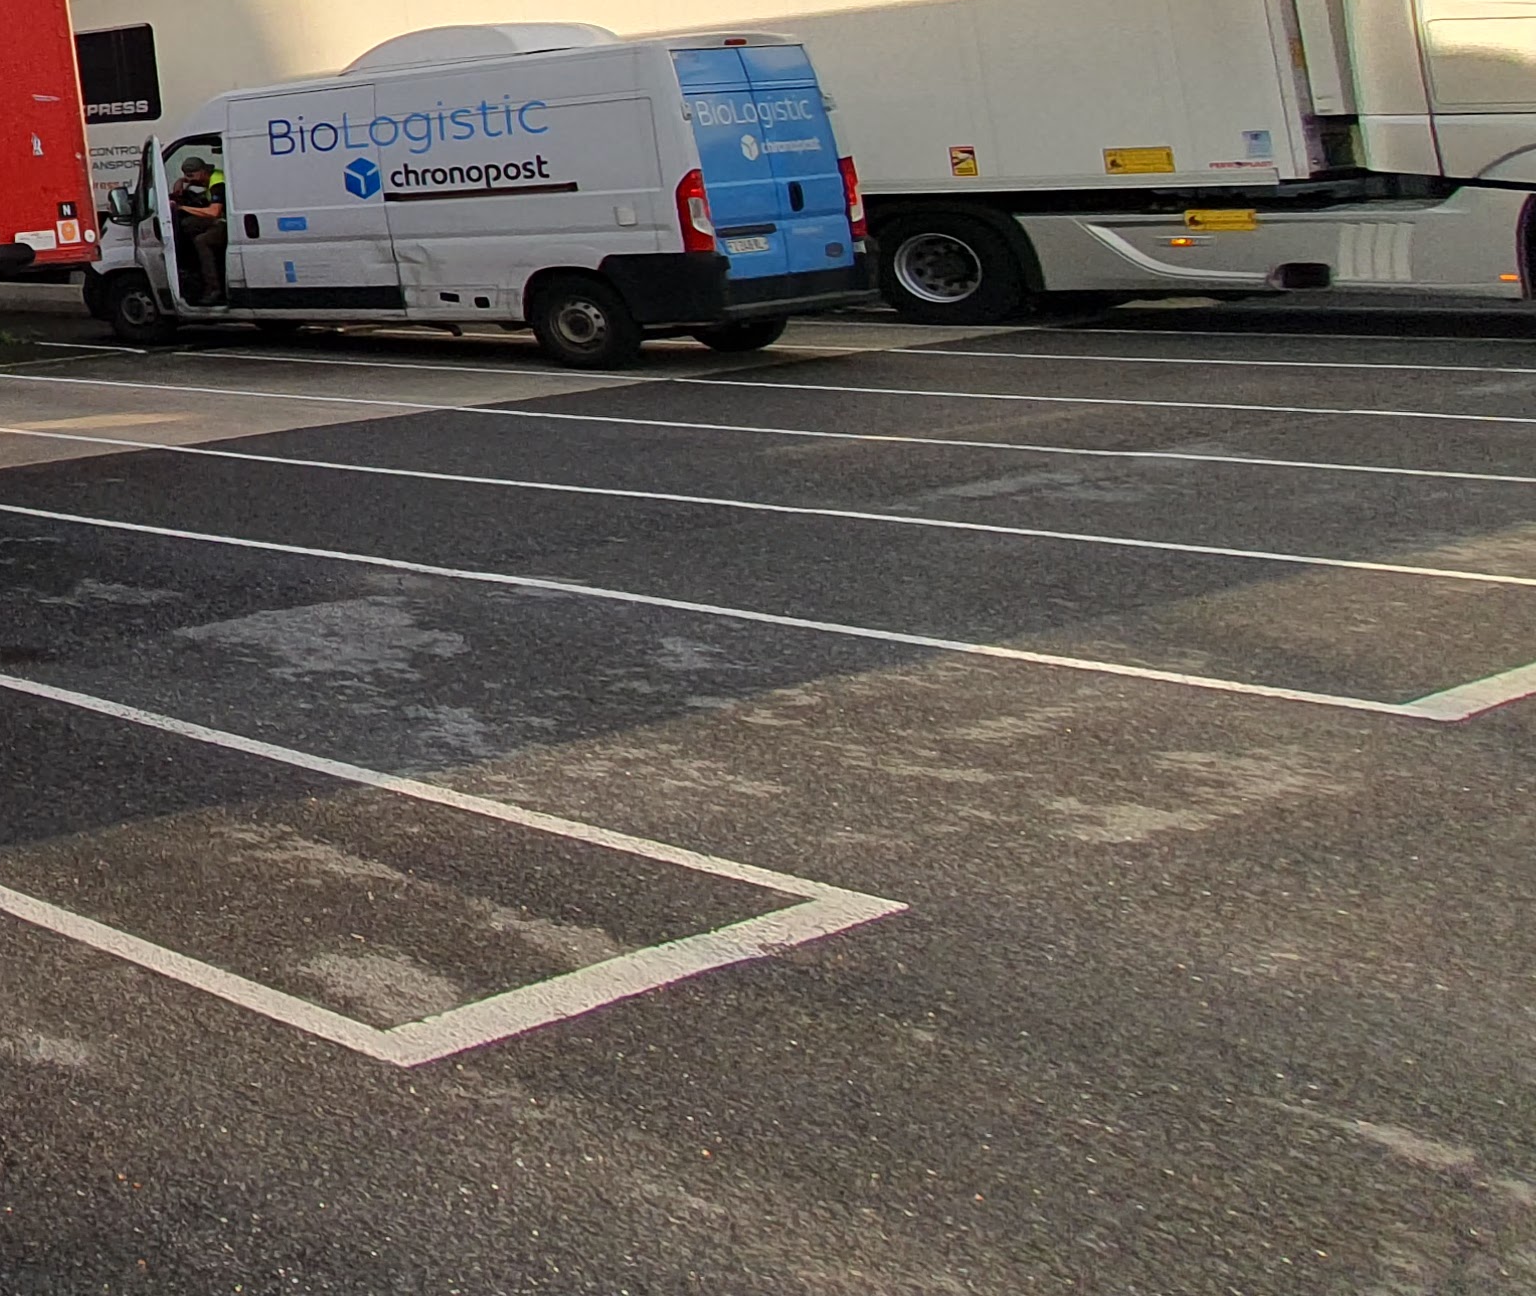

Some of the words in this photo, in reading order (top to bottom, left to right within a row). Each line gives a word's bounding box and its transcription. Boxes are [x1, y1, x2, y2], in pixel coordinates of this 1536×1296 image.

[83, 100, 149, 117] PRESS
[695, 95, 813, 128] BioLogistic
[268, 94, 549, 155] BioLogistic
[761, 138, 821, 154] chronopost
[92, 159, 142, 171] ANSPOR
[390, 155, 550, 188] chronopost
[62, 204, 71, 216] N
